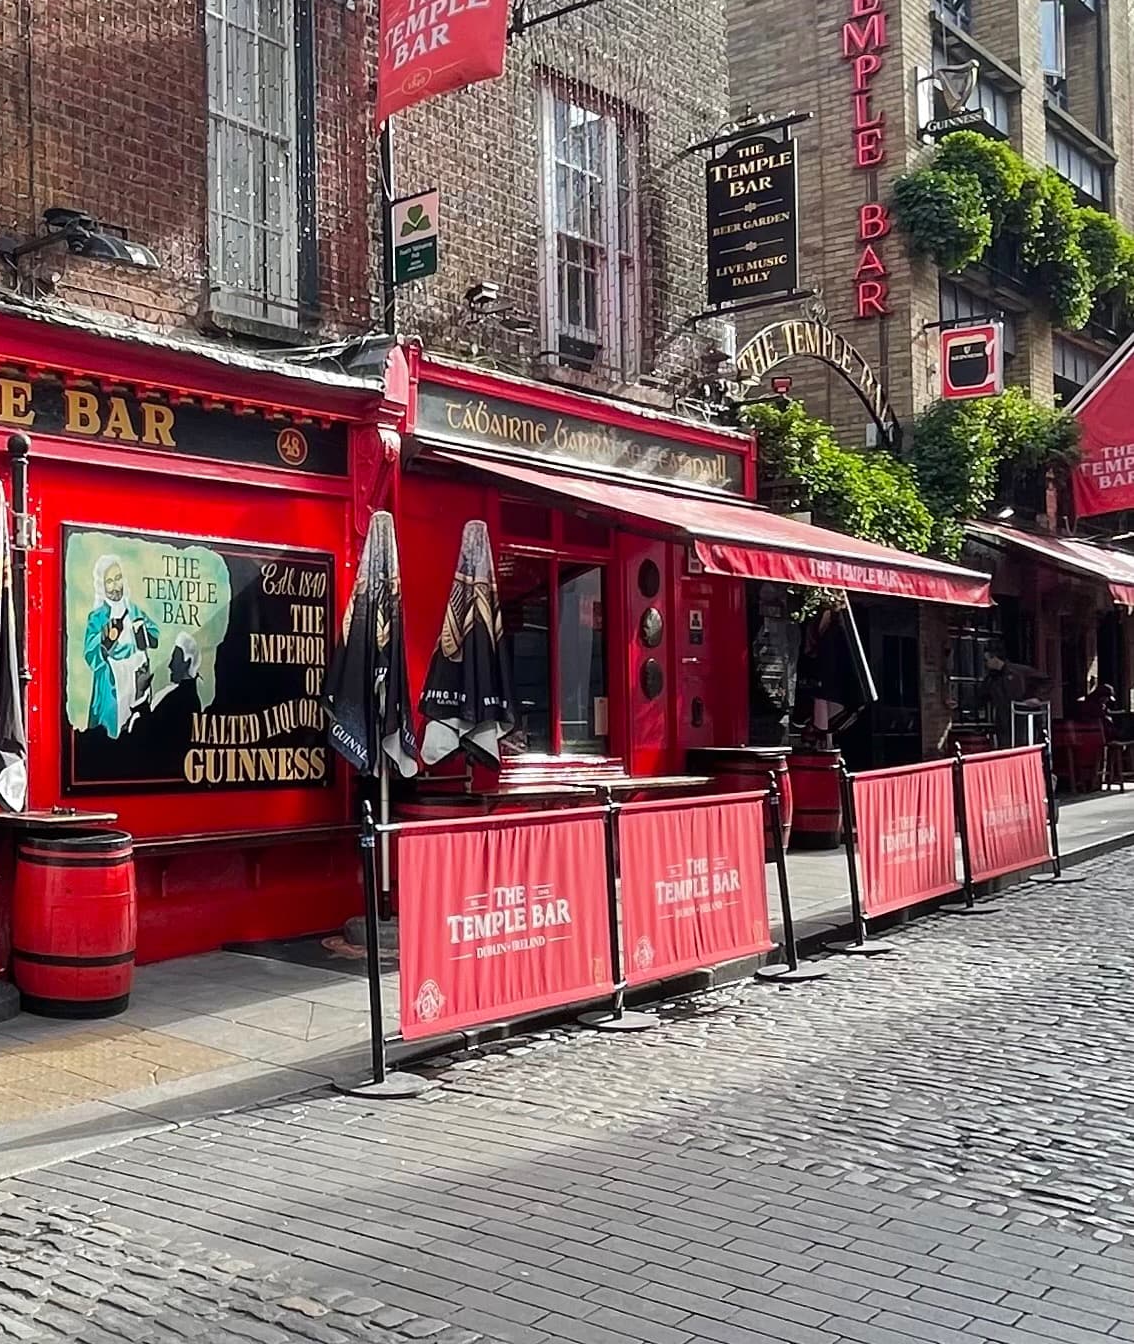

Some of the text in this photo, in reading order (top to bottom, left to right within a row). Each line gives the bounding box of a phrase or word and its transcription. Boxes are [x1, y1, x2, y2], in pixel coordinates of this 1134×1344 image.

[392, 22, 451, 71] BAR
[926, 112, 983, 132] GUINNESS
[736, 143, 765, 159] THE
[709, 151, 793, 183] TEMPLE
[729, 176, 774, 199] BAR
[712, 211, 792, 237] BEER GARDEN
[716, 254, 788, 278] LIVE MUSIC
[854, 203, 890, 317] BAR
[732, 270, 771, 288] DAILY
[737, 329, 779, 377] THE
[780, 320, 853, 374] TEMPLE
[65, 389, 178, 448] BAR
[281, 433, 300, 458] 48
[1101, 443, 1134, 459] THE
[162, 554, 201, 580] THE
[809, 558, 833, 579] THE
[834, 561, 876, 585] TEMPLE
[877, 568, 900, 588] BAR
[142, 576, 219, 605] TEMPLE
[297, 570, 327, 599] 1840
[162, 601, 203, 628] BAR
[289, 603, 325, 635] THE
[249, 633, 326, 666] EMPEROR
[305, 668, 323, 697] OF
[190, 711, 260, 745] MALTED
[183, 746, 326, 784] GUINNESS
[686, 858, 709, 876] THE
[493, 885, 526, 908] THE
[654, 869, 741, 906] TEMPLE BAR
[446, 898, 572, 945] TEMPLE BAR
[511, 935, 546, 953] IRELAND
